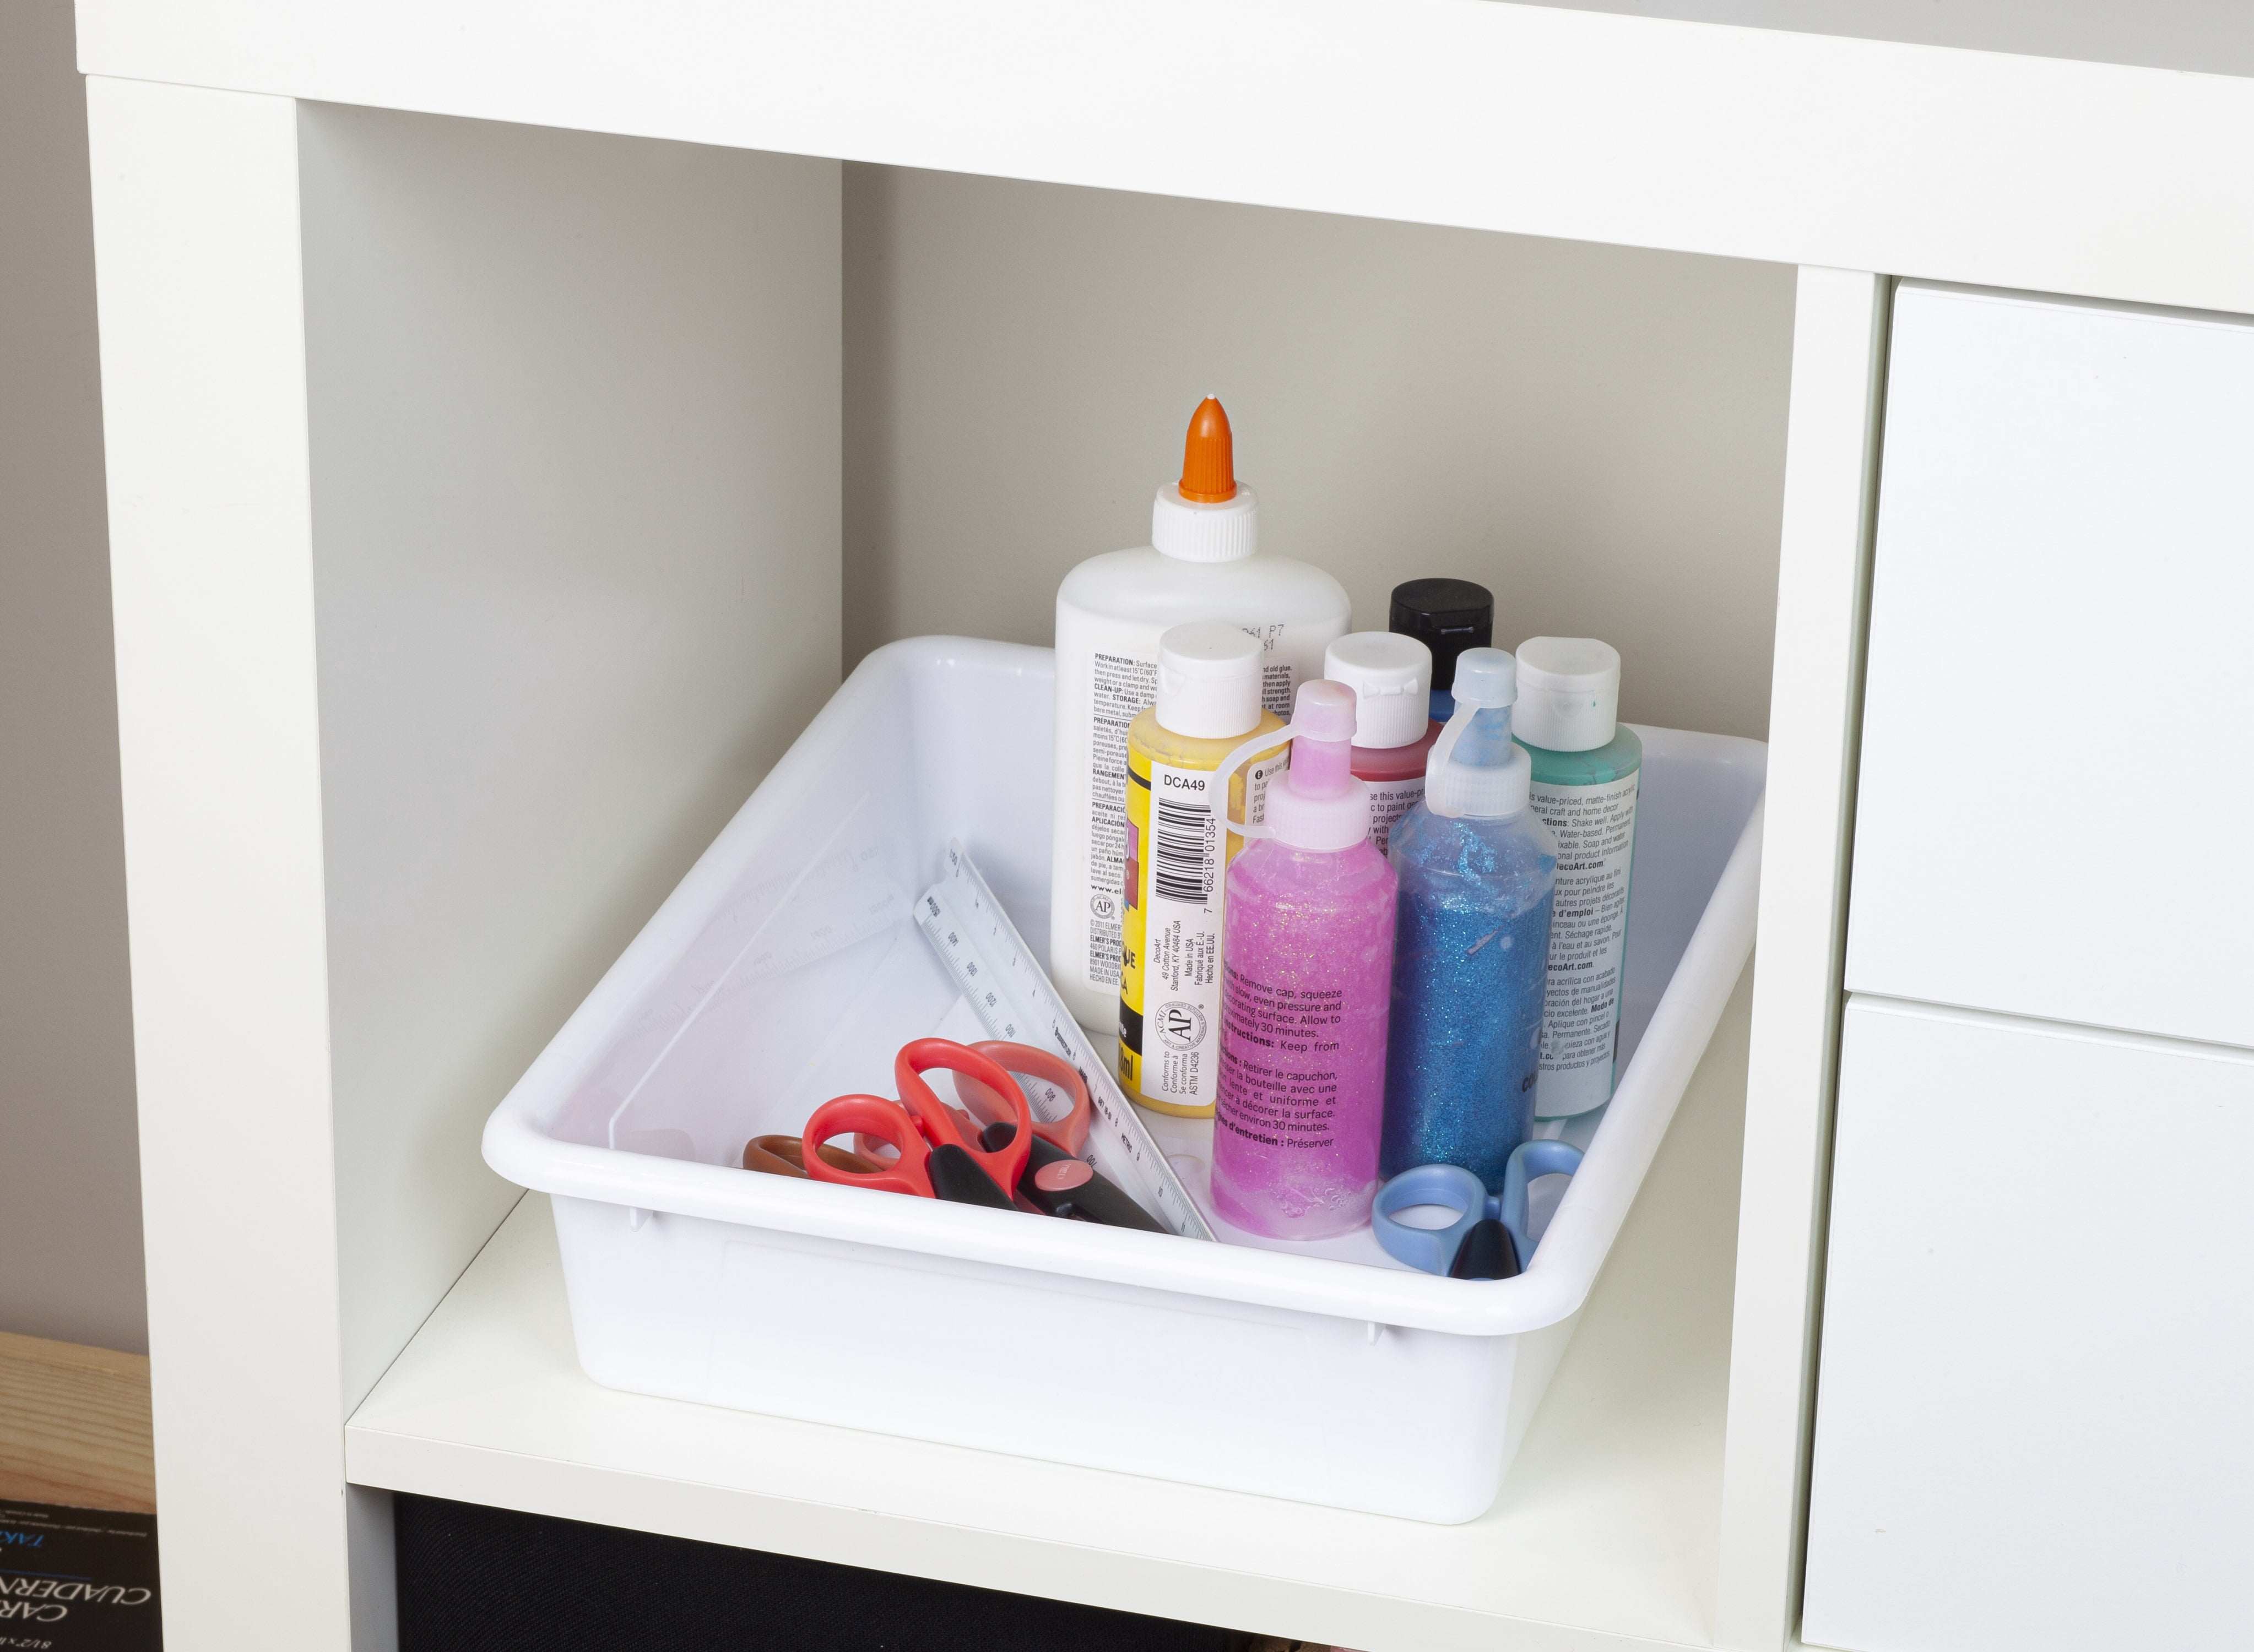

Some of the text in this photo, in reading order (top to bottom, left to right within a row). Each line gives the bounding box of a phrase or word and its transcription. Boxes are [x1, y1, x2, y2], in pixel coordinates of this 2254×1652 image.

[1269, 624, 1284, 638] P7
[1095, 653, 1135, 666] PREPARATION:
[1095, 683, 1123, 694] CLEAN-UP:
[1094, 699, 1127, 709] temperature.
[1113, 694, 1140, 704] STORAGE:
[1093, 741, 1118, 749] poreuses,
[1163, 774, 1205, 792] DCA49
[1092, 791, 1117, 801] chauffées
[1102, 786, 1123, 795] nettoyer
[1537, 790, 1621, 806] value-priced, matte-finish
[1387, 802, 1405, 813] paint
[1583, 807, 1601, 816] home
[1603, 803, 1619, 813] decor
[1595, 816, 1608, 825] well.
[1610, 812, 1624, 823] Apply
[1204, 818, 1216, 851] 01354
[1373, 825, 1388, 834] with
[1561, 818, 1630, 838] Water-based. Permanent
[1583, 837, 1612, 849] Soap and
[1574, 840, 1628, 861] product information
[1204, 859, 1214, 892] 66218
[1575, 875, 1605, 885] acrylique
[1564, 885, 1605, 897] pour peindre
[1096, 900, 1110, 912] AP
[1579, 896, 1601, 907] projets
[1091, 927, 1117, 938] DISTRIBUTED
[1565, 930, 1593, 939] Séchage
[948, 932, 959, 947] 1400
[1091, 935, 1109, 944] ELMER'S
[1206, 933, 1215, 954] EE.UU.
[1594, 936, 1610, 945] savon.
[1090, 950, 1109, 960] ELMER'S
[1098, 945, 1118, 954] POLARIS
[1568, 950, 1591, 961] produit
[1172, 953, 1178, 962] KY
[967, 961, 978, 976] 1300
[1090, 966, 1103, 974] MADE
[1195, 956, 1205, 985] Fabriqué
[1596, 967, 1615, 980] acabado
[1090, 974, 1104, 982] HECHO
[1171, 964, 1180, 991] Stanford,
[1240, 974, 1342, 1001] Remove cap, squeeze
[985, 992, 997, 1007] 1200
[1235, 985, 1341, 1012] slow, even pressure and
[1584, 993, 1600, 1003] hogar
[1557, 1003, 1607, 1017] excelente. Modo
[1158, 1010, 1166, 1034] ACMI
[1258, 1009, 1296, 1024] surface.
[1300, 1015, 1328, 1025] Allow
[1548, 1018, 1574, 1029] Aplique
[1590, 1014, 1605, 1025] pincel
[1005, 1024, 1016, 1037] 1100
[1168, 1009, 1191, 1042] AP
[1196, 1022, 1205, 1042] MATERIALS
[1261, 1023, 1319, 1037] 30 minutes.
[1553, 1029, 1591, 1039] Permanente.
[1281, 1040, 1339, 1053] Keep from
[1243, 1060, 1337, 1083] Retirer le capuchon,
[1556, 1059, 1585, 1072] productos
[1189, 1052, 1199, 1095] ASTM D4236
[1246, 1075, 1337, 1094] bouteille avec une
[1045, 1088, 1055, 1102] 800
[1229, 1077, 1336, 1106] lente uniforme et
[1243, 1100, 1335, 1118] décorer la surface.
[1240, 1112, 1329, 1132] environ 30 minutes.
[1287, 1138, 1333, 1148] Préserver
